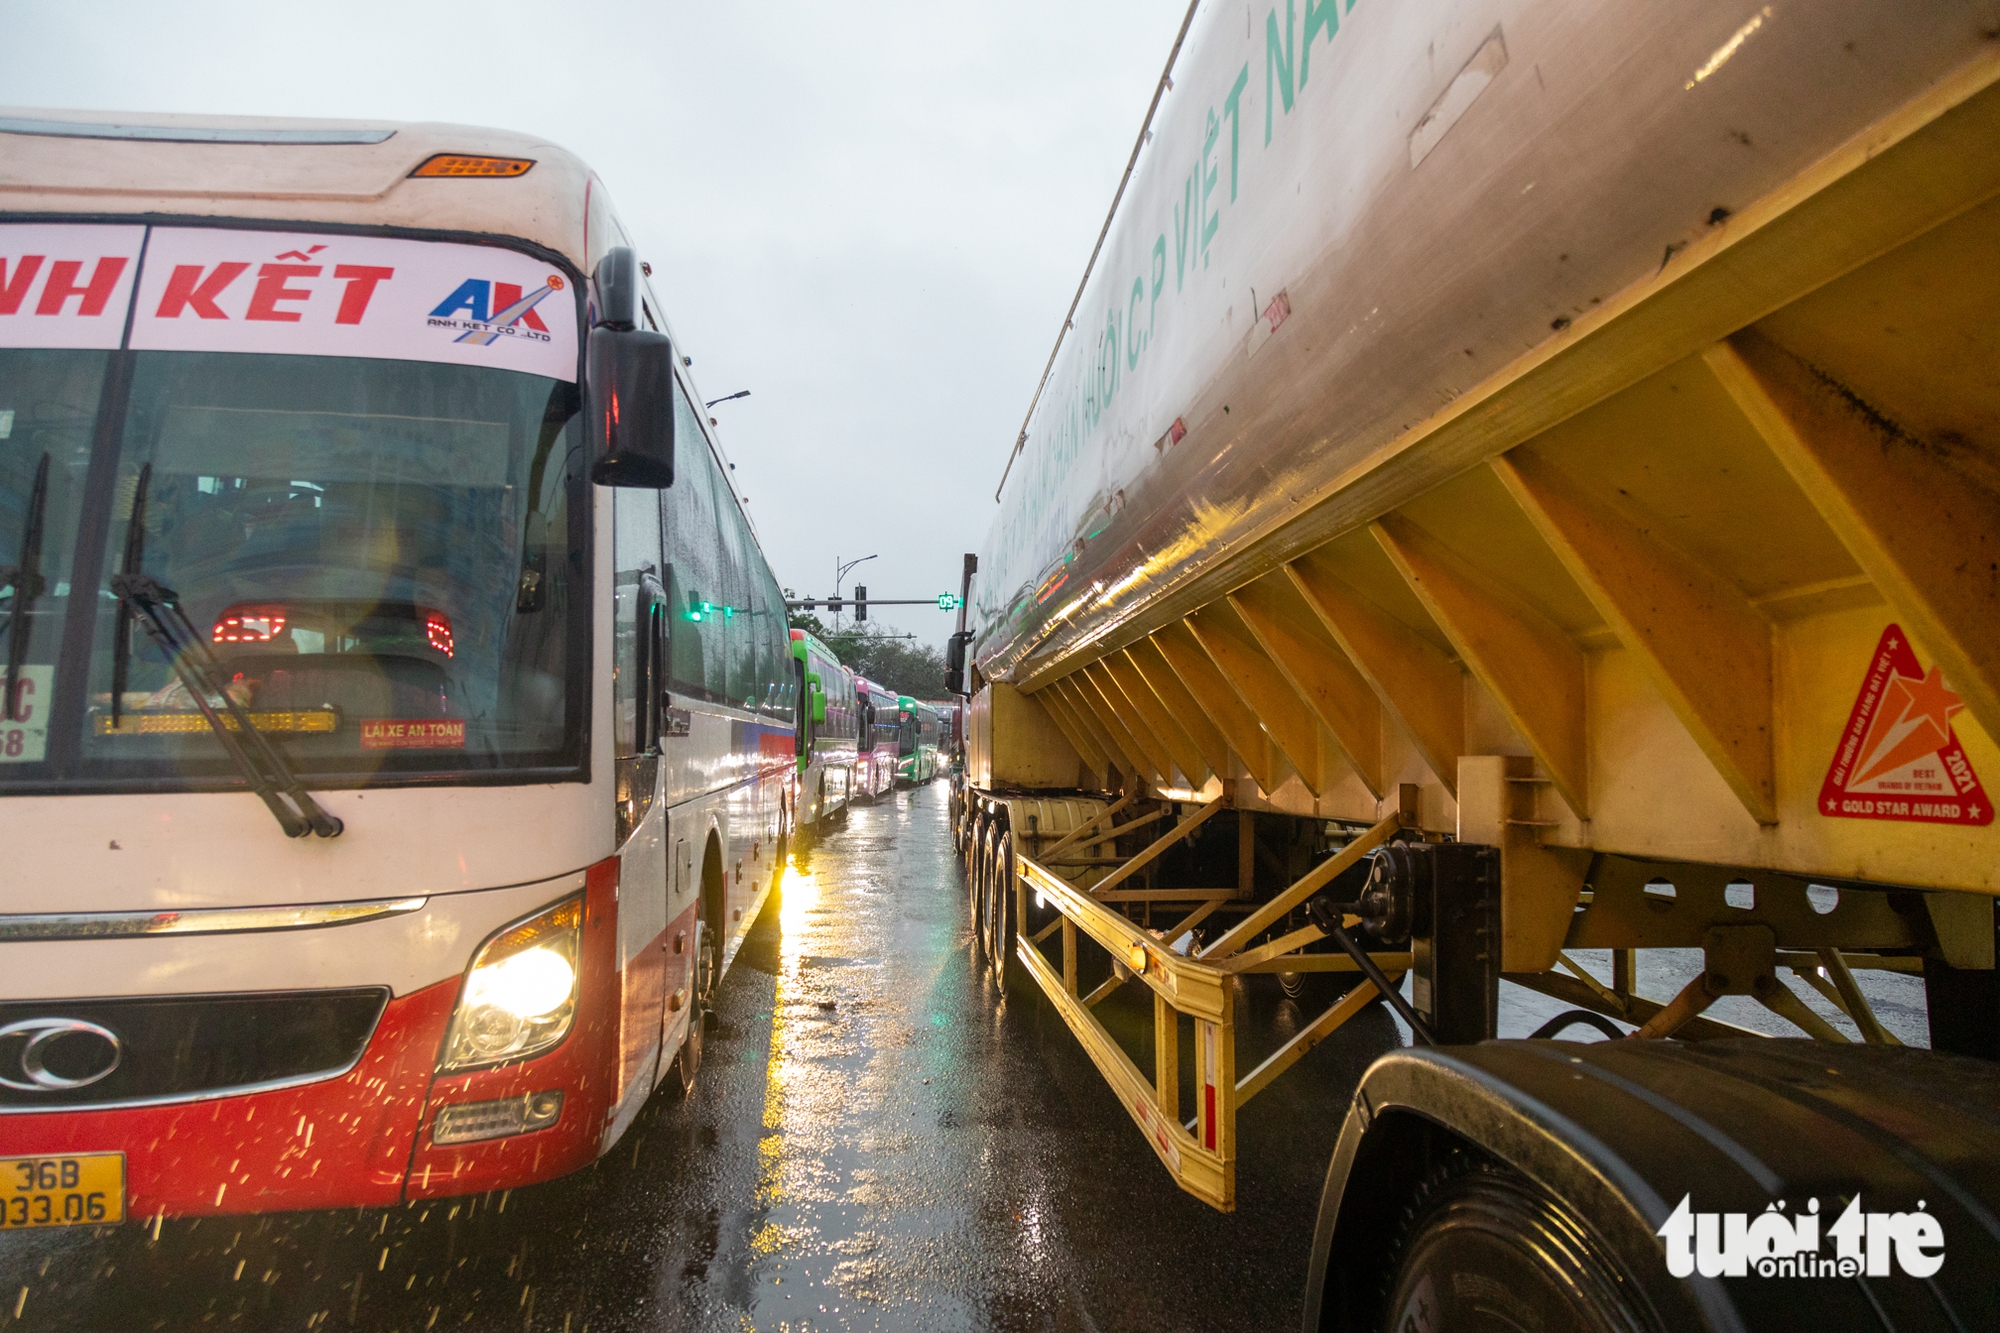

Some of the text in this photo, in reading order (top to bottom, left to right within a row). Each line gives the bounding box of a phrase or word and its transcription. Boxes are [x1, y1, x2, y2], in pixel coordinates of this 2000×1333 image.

[1082, 307, 1122, 447] NUÔI
[1128, 233, 1166, 372] C.P
[1174, 60, 1249, 295] VIỆT
[155, 245, 395, 325] KẾT
[428, 278, 549, 333] AK
[427, 318, 457, 328] ANH
[462, 321, 492, 331] KET
[496, 326, 515, 335] CO
[939, 595, 953, 608] 09
[364, 721, 463, 738] LÁI XE AN TOÀN
[1913, 769, 1935, 779] BEST
[1945, 750, 1977, 794] 2021
[1842, 799, 1961, 818] GOLD STAR AWARD
[16, 1160, 80, 1191] 36B
